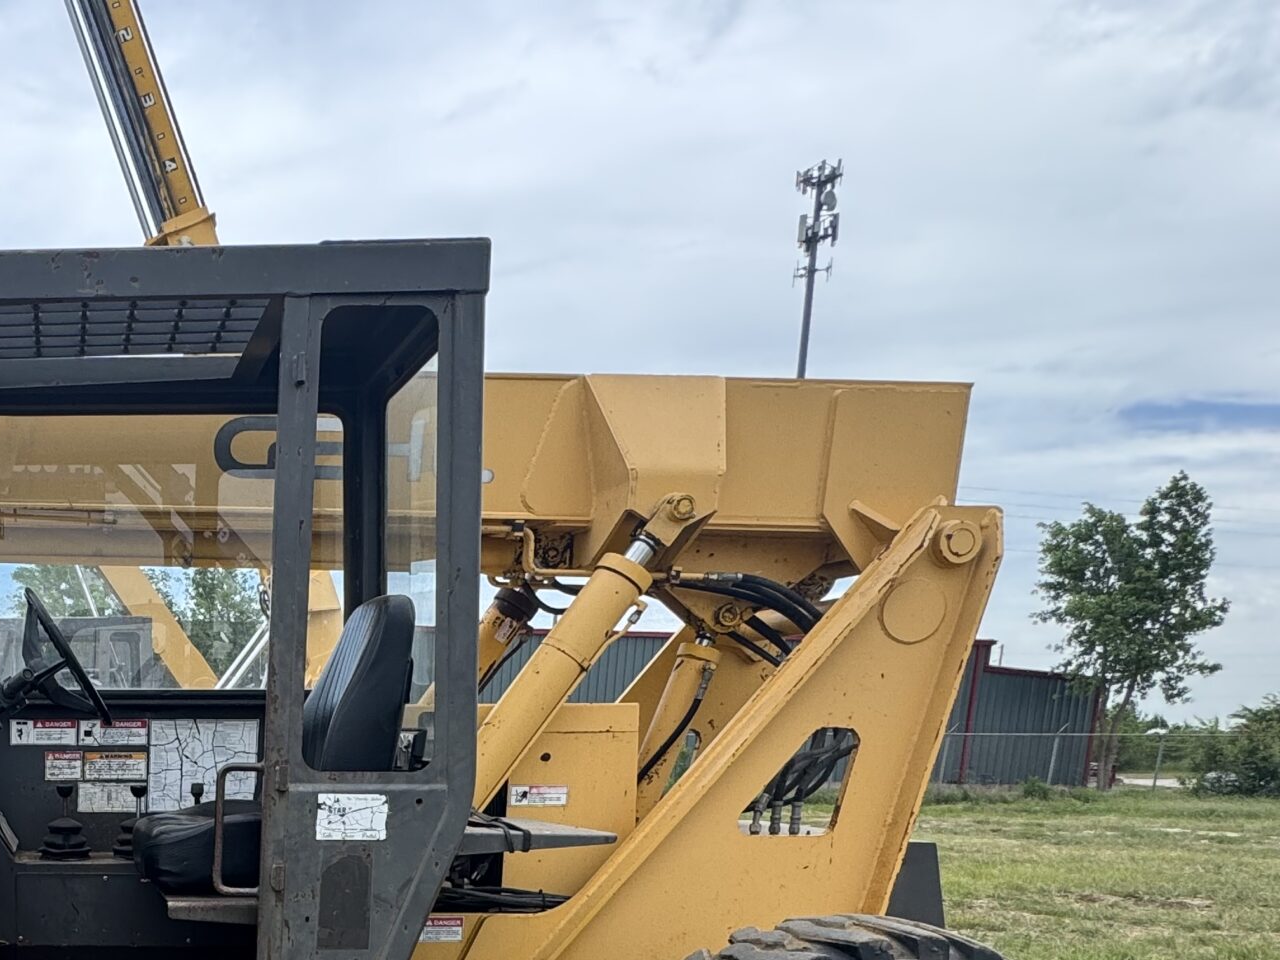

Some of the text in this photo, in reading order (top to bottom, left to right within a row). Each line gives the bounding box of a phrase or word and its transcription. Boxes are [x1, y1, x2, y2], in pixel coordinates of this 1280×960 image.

[119, 27, 133, 43] 2
[141, 94, 155, 108] 3
[164, 160, 177, 173] 4
[44, 720, 72, 728] DANGER
